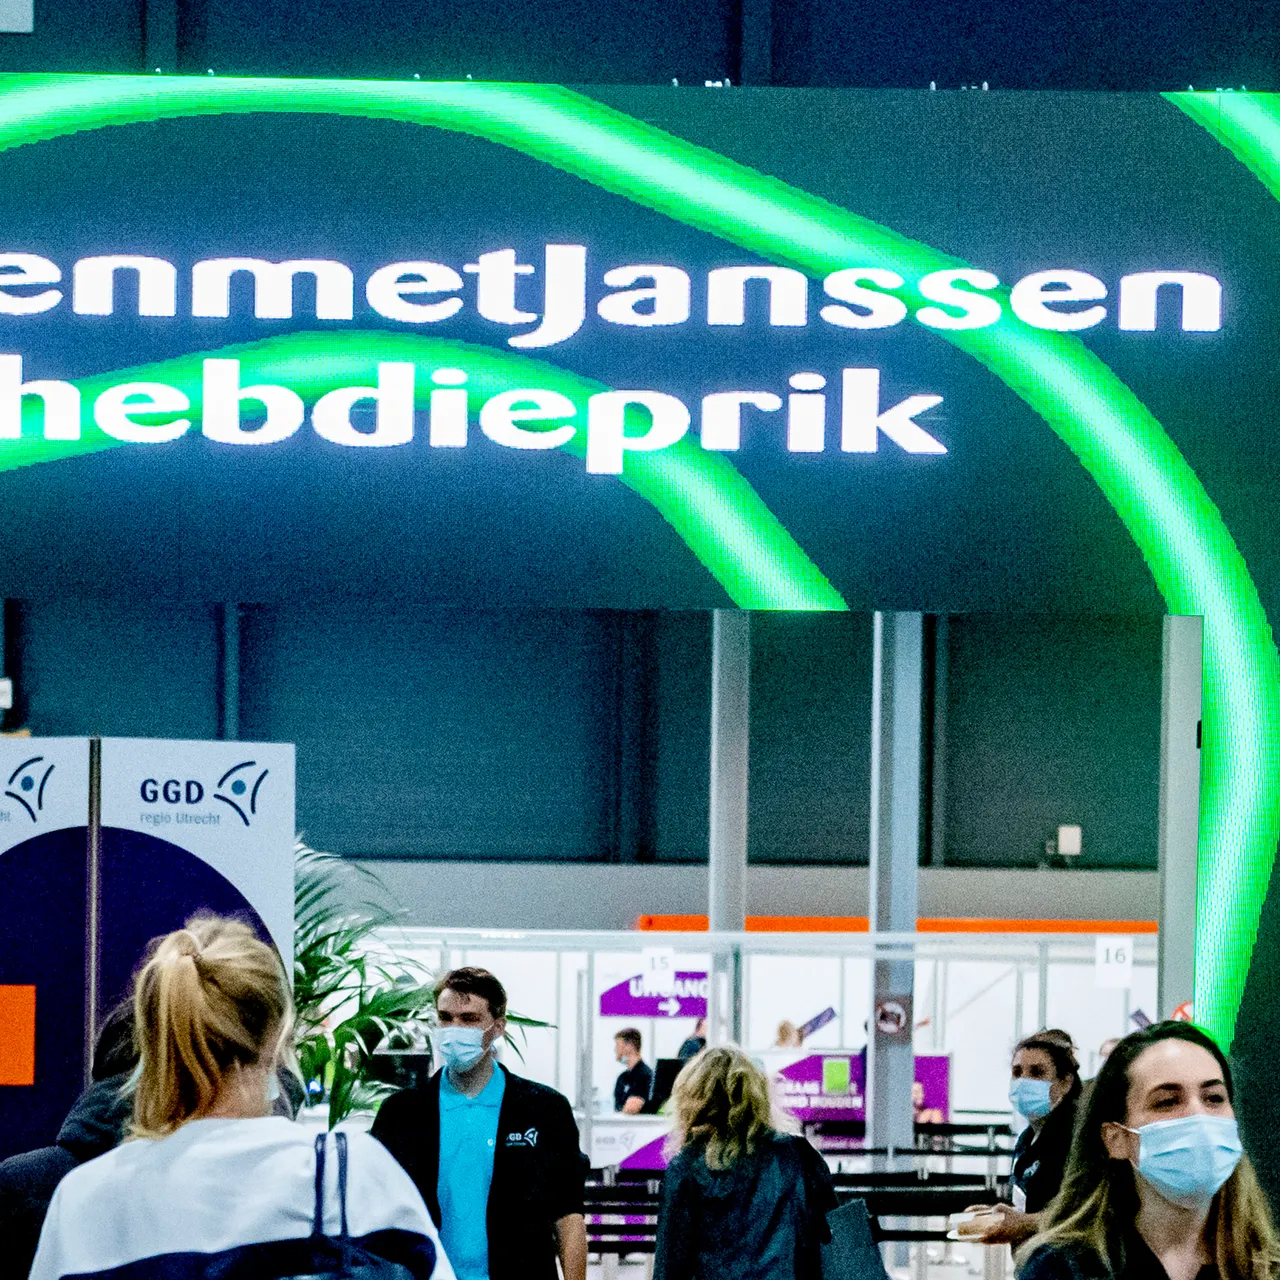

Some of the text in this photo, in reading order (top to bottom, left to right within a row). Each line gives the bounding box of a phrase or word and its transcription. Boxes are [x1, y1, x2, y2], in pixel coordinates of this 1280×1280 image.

[140, 778, 204, 804] GGD
[140, 812, 220, 826] regio Utrecht
[1104, 947, 1126, 964] 16
